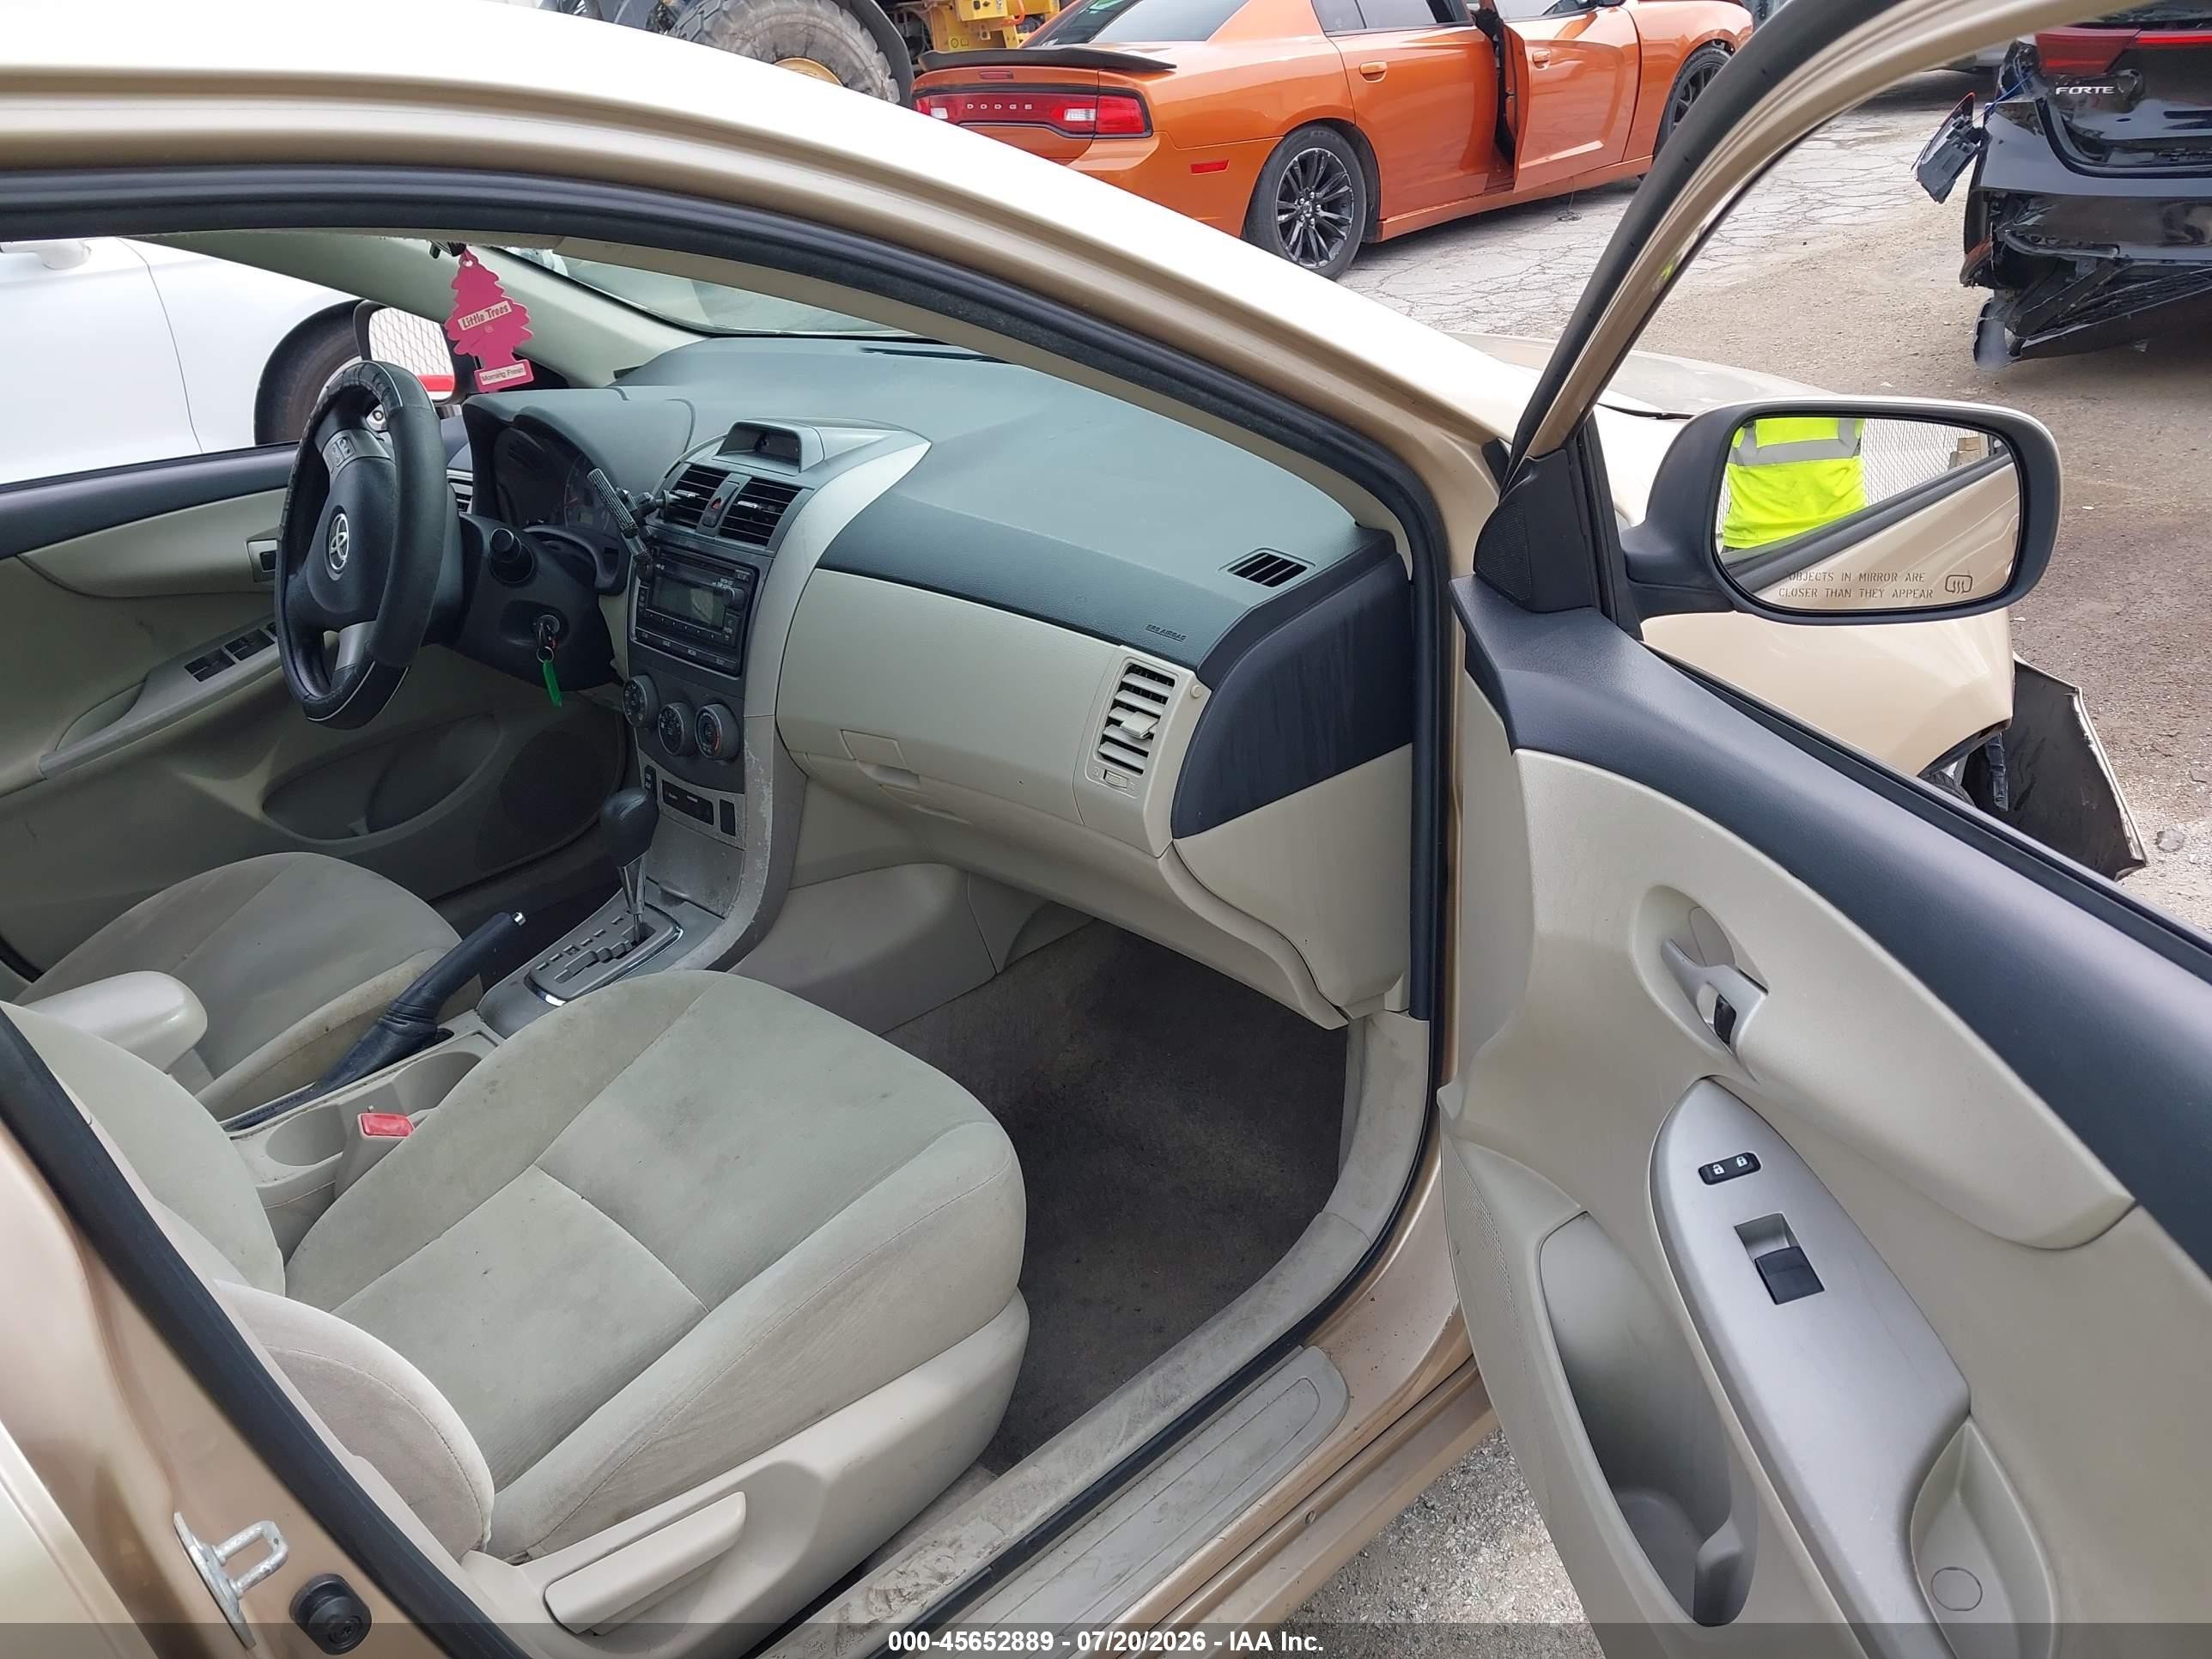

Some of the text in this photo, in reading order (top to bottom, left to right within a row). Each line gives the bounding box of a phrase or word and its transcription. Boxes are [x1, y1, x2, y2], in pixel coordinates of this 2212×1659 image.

[2055, 86, 2115, 95] FORTE
[461, 304, 510, 328] Little Trees
[1789, 571, 1926, 582] OBJECTS IN MIRROR ARE
[1778, 587, 1934, 599] CLOSER THAN THEY APPEAR
